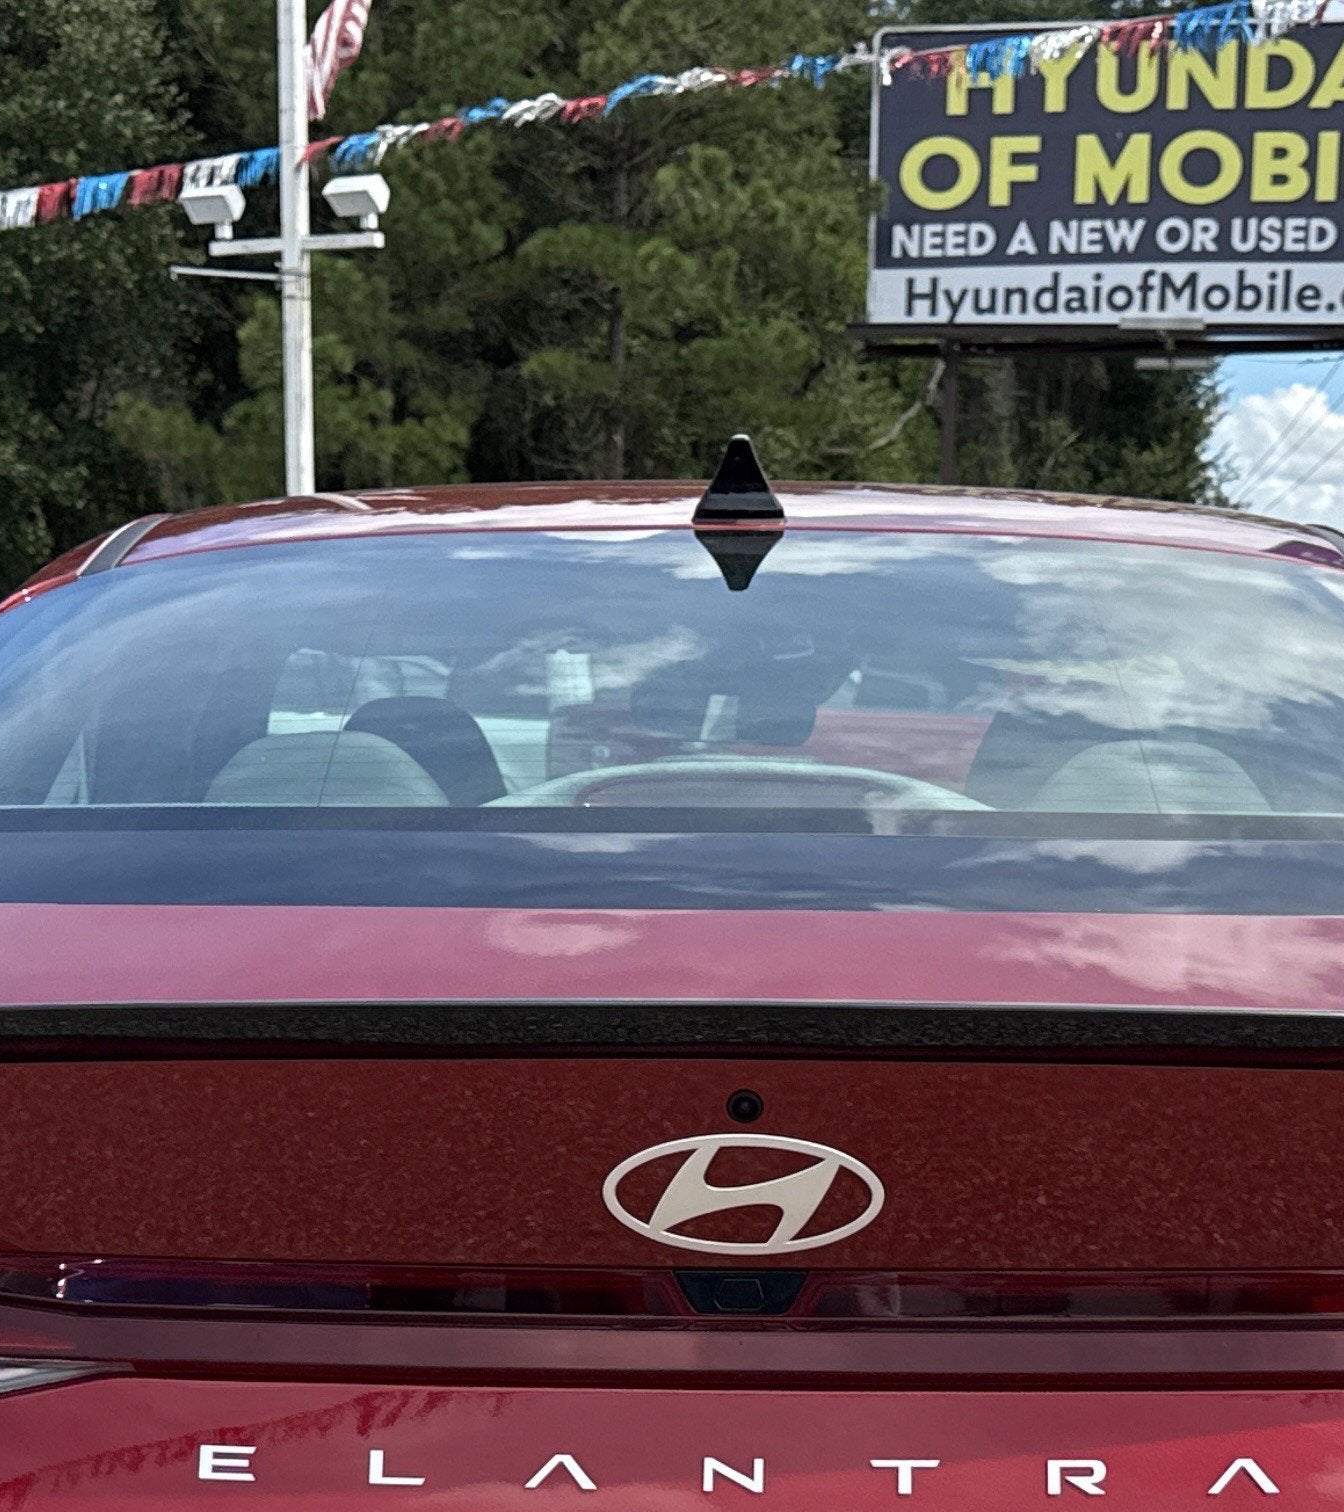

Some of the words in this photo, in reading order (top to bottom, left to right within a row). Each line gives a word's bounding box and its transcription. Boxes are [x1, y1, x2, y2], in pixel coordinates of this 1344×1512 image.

[899, 134, 1042, 211] OF
[890, 221, 997, 258] NEED
[1006, 220, 1038, 255] A
[1048, 218, 1147, 254] NEW
[1155, 216, 1220, 253] OR
[1230, 216, 1338, 253] USED
[198, 1444, 1280, 1495] ELANTRA
